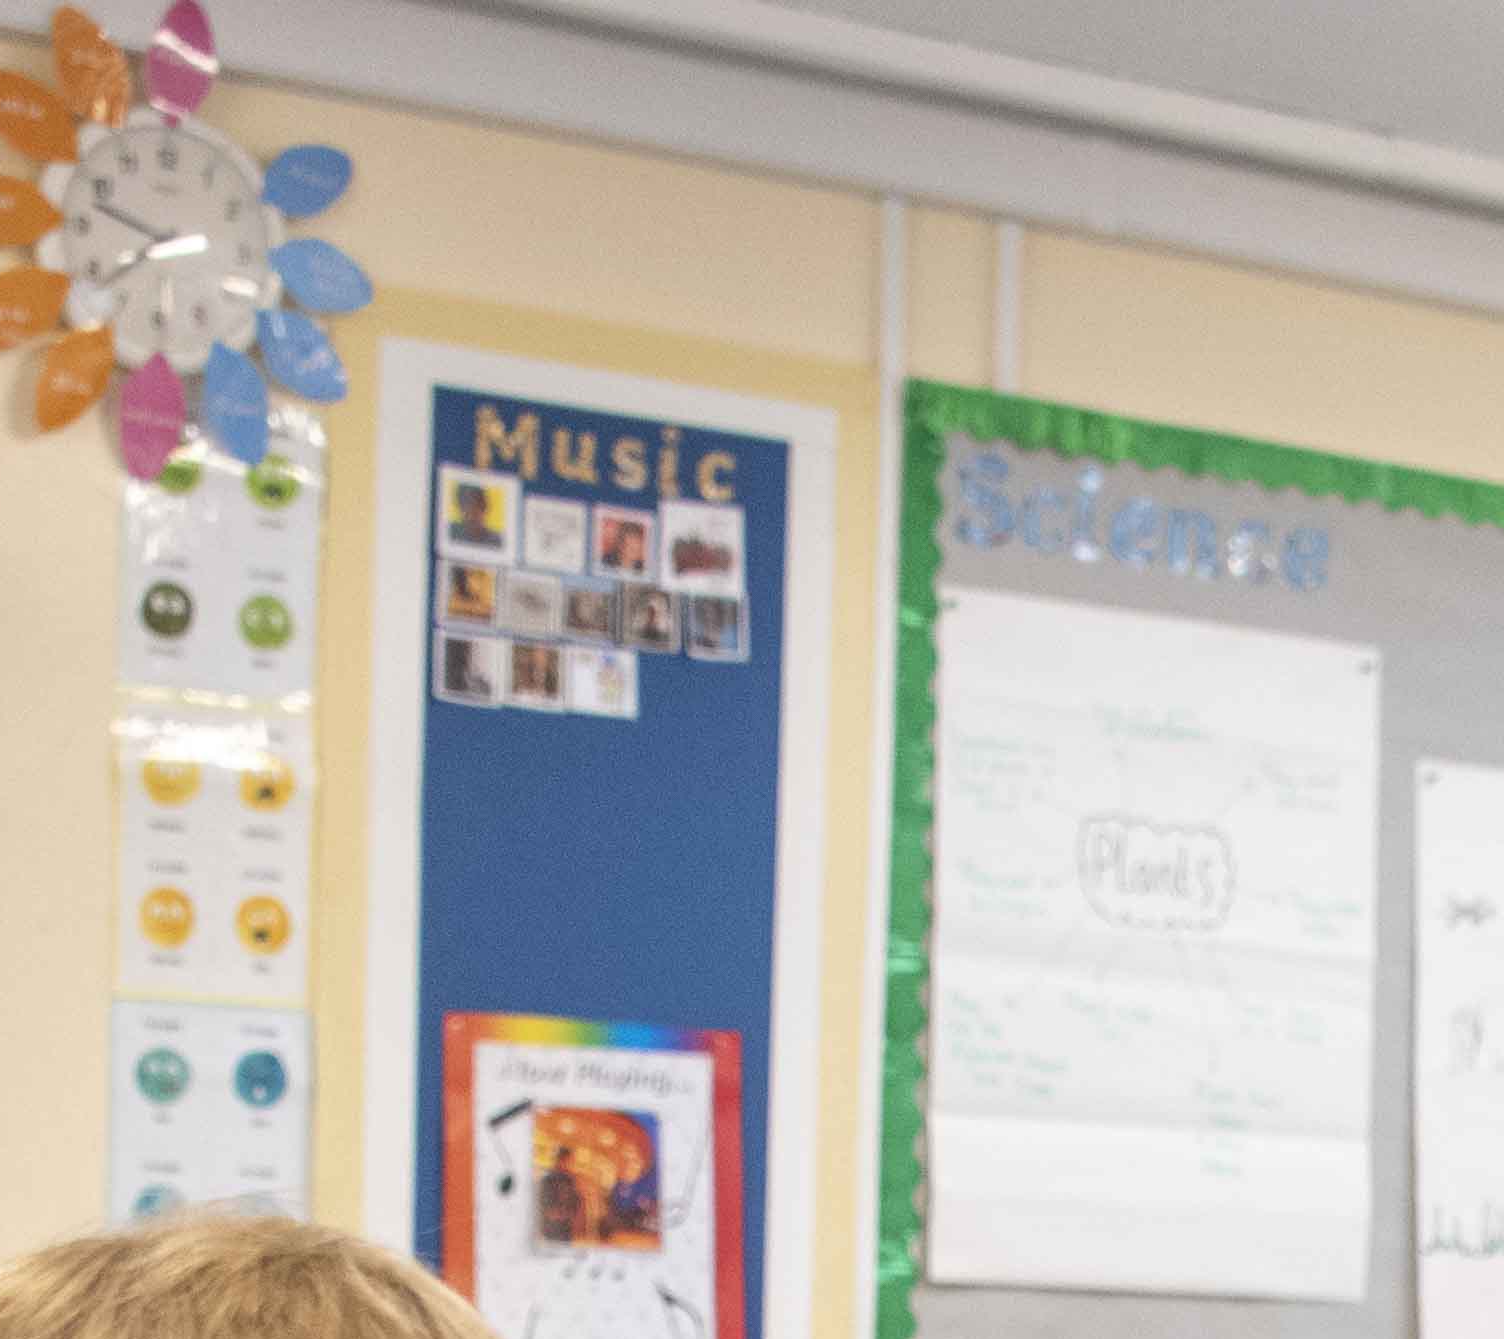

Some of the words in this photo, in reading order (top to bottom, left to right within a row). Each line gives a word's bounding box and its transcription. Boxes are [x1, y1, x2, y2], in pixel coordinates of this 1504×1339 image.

[471, 405, 740, 502] Music
[954, 448, 1334, 592] Science
[1089, 825, 1218, 913] Plants
